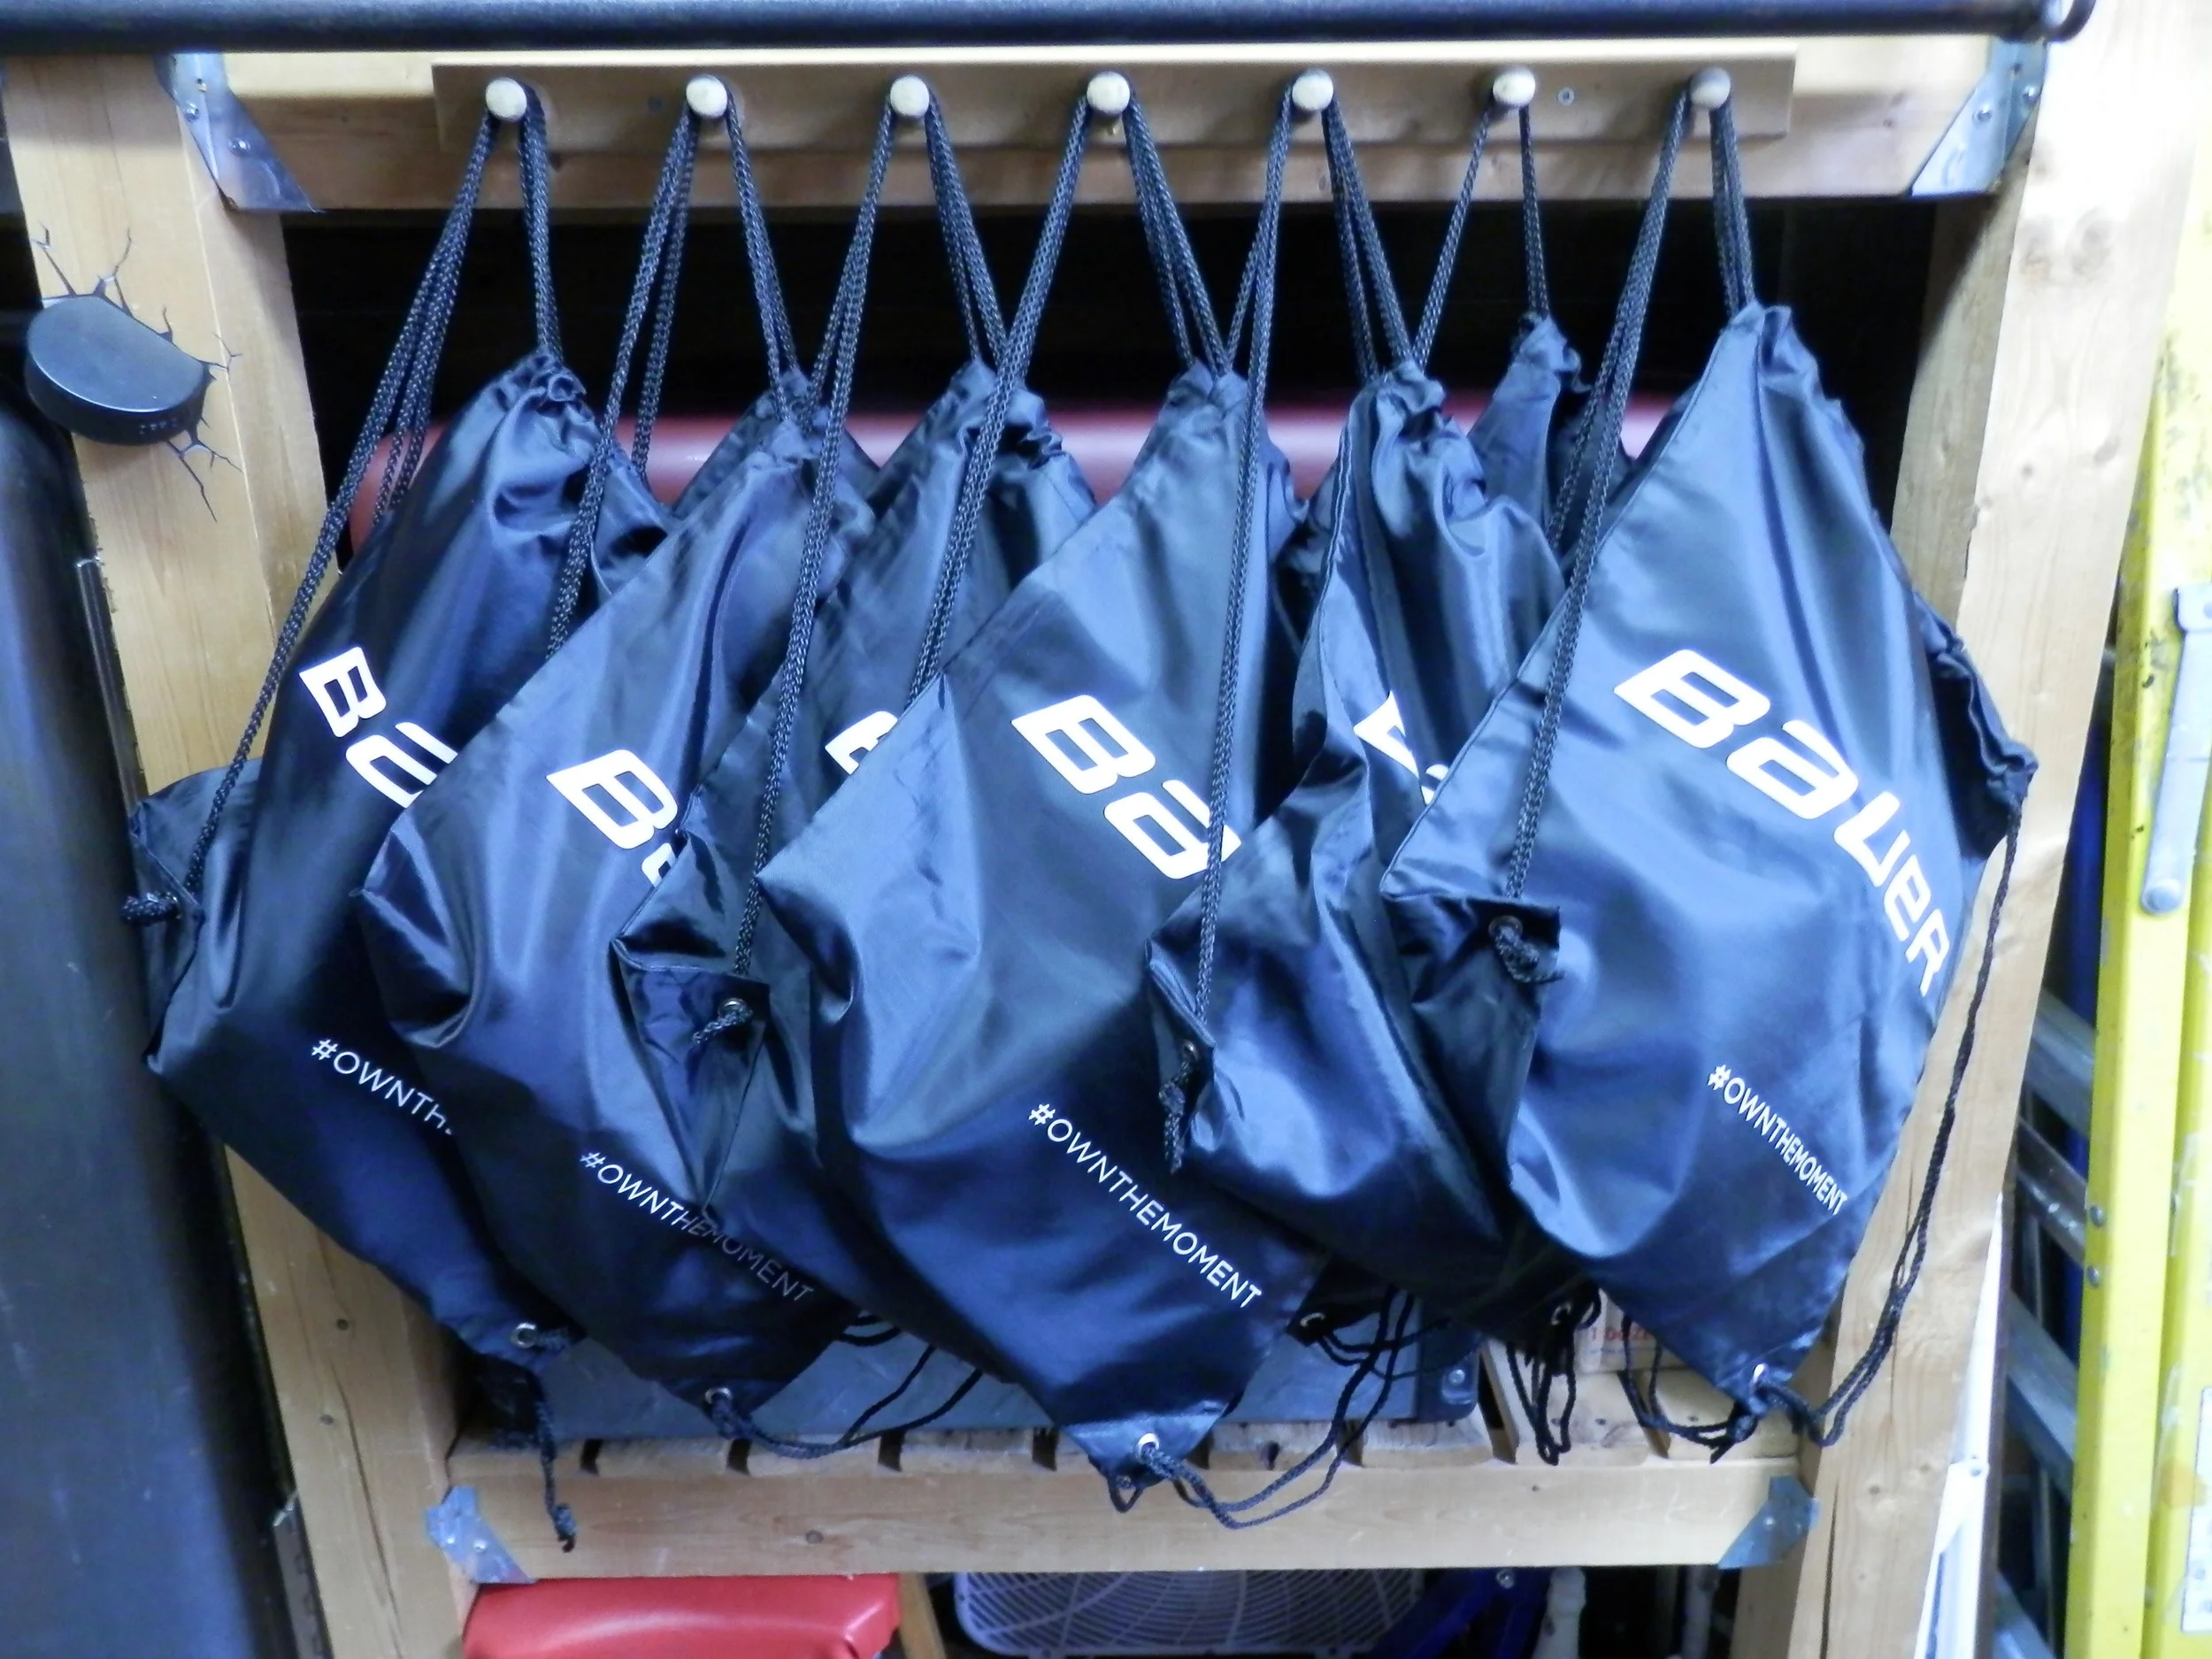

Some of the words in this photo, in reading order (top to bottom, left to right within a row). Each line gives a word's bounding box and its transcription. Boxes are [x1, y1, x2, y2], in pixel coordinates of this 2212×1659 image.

[1029, 1103, 1263, 1308] #OWNTHEMOMENT
[1708, 1064, 1847, 1215] #OWNTHEMOMENT
[580, 1151, 814, 1302] #OWNTHEMOMENT
